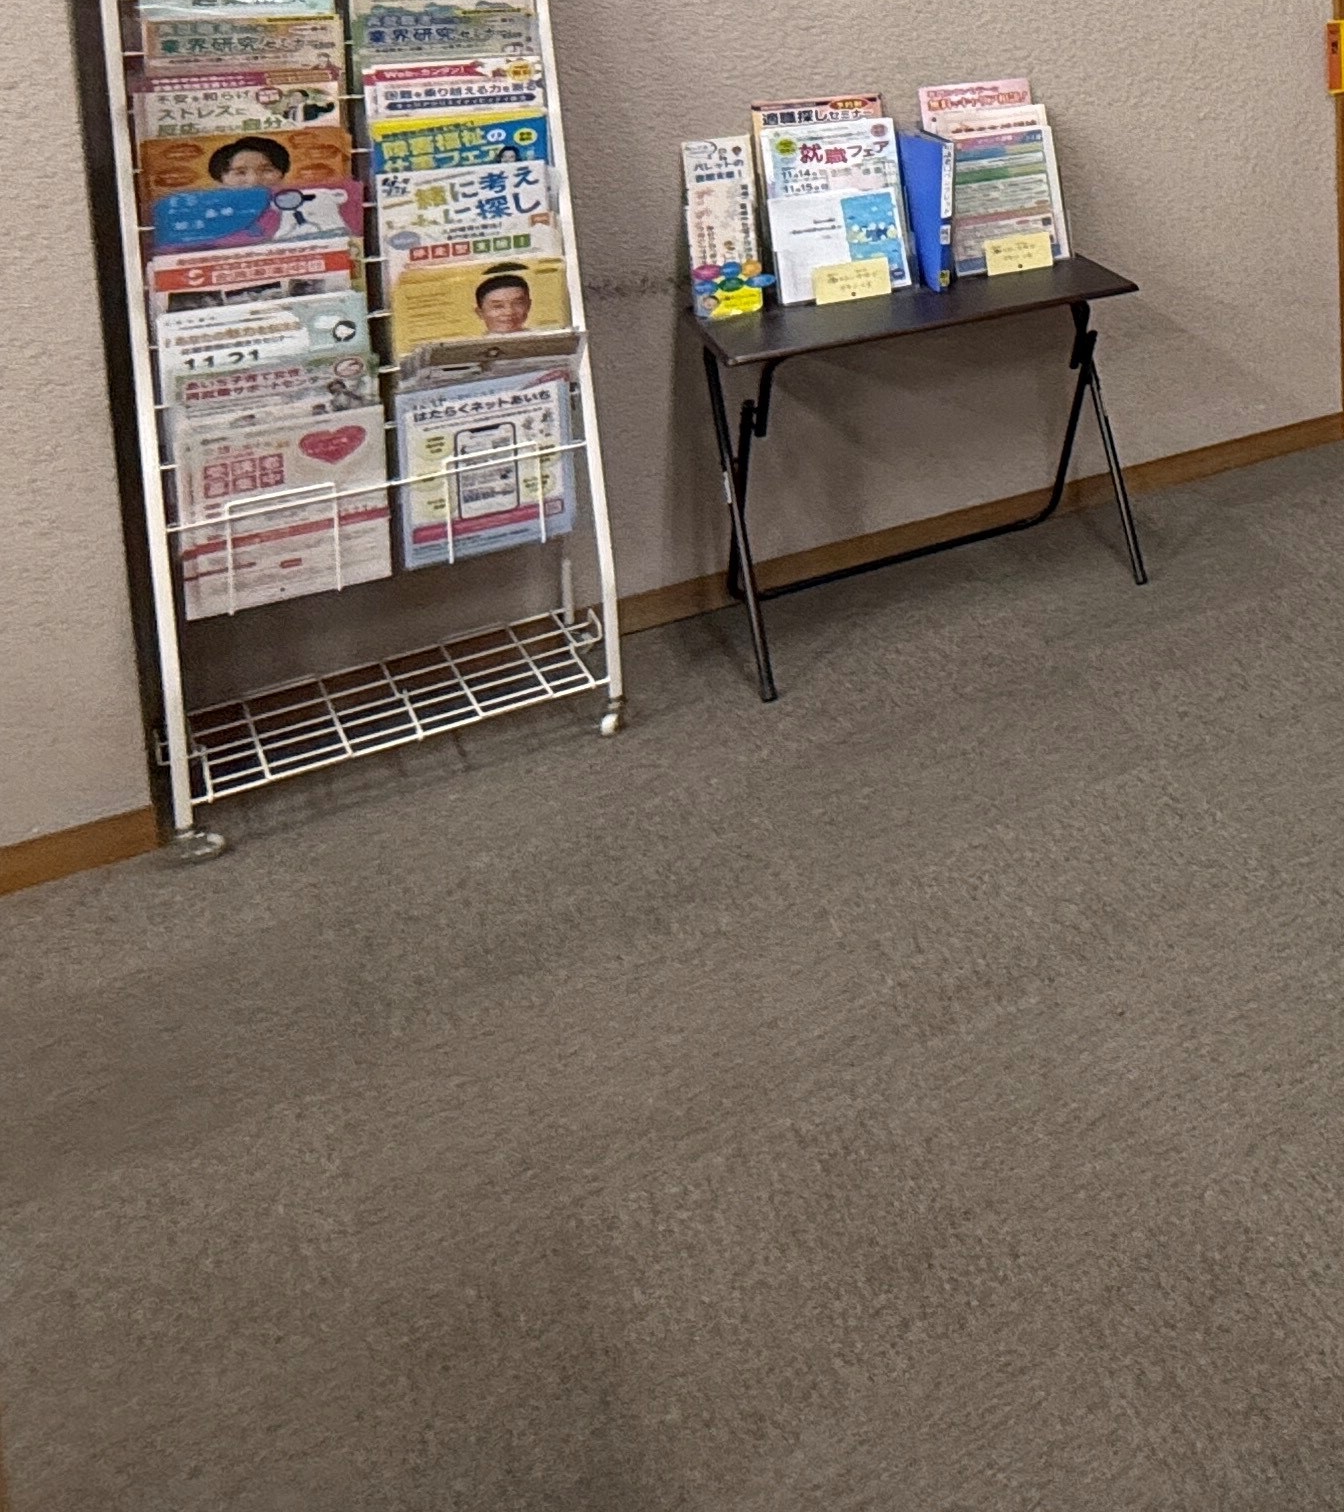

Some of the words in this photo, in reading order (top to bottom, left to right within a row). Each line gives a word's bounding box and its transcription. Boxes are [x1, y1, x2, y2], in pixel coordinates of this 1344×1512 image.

[799, 140, 890, 165] 就職フェア
[412, 389, 552, 424] はたらくネットあいち
